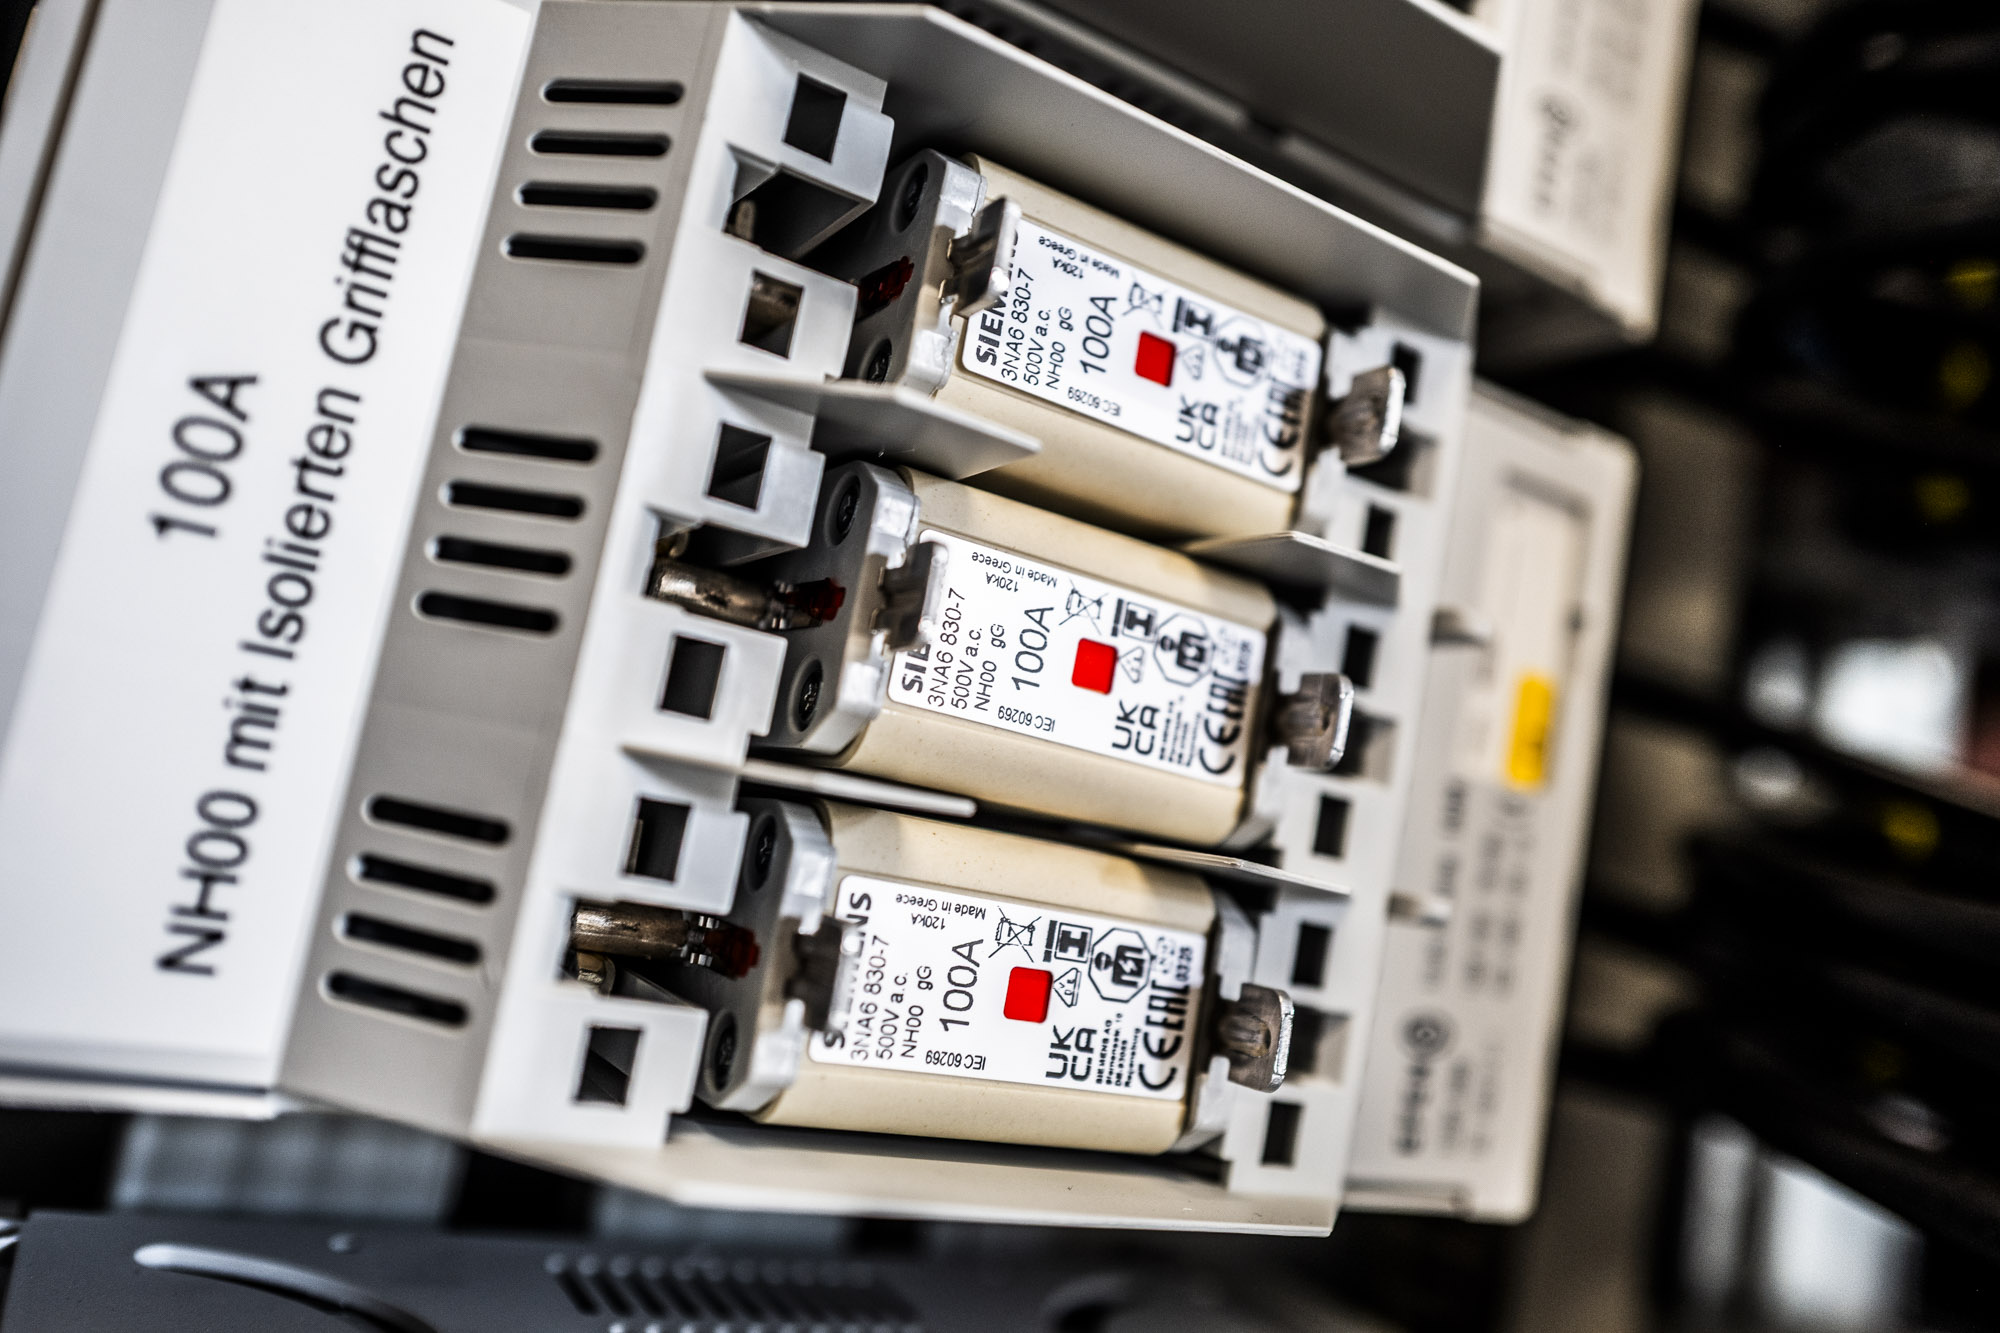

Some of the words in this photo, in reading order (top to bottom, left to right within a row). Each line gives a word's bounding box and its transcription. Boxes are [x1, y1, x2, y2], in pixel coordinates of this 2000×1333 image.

[319, 27, 456, 366] Grifflaschen
[1038, 235, 1077, 261] Greece
[1011, 267, 1035, 324] 830-7
[1001, 327, 1025, 381] 3NA6
[1023, 337, 1045, 386] 500V
[1036, 309, 1051, 337] a.c.
[1045, 341, 1066, 390] NH00
[1058, 306, 1075, 332] gG
[1079, 296, 1118, 374] 100A
[1103, 399, 1121, 417] IEC
[149, 374, 259, 540] 100A
[240, 385, 361, 660] Isolierten
[971, 551, 1012, 574] Greece
[985, 571, 1019, 593] 120kA
[1015, 564, 1025, 579] in
[1027, 569, 1058, 588] Made
[940, 587, 965, 645] 830-7
[951, 659, 975, 710] 500V
[965, 627, 982, 657] a.c.
[974, 660, 997, 711] NH00
[990, 624, 1006, 649] gG
[1011, 607, 1054, 691] 100A
[927, 650, 954, 707] 3NA6
[223, 676, 291, 772] mit
[998, 705, 1033, 726] 60269
[1034, 715, 1056, 733] IEC
[1112, 700, 1139, 750] UK
[1135, 705, 1160, 755] CA
[155, 788, 259, 976] NH00
[895, 893, 938, 912] Greece
[941, 902, 952, 915] in
[911, 912, 946, 930] 120kA
[954, 903, 987, 921] Made
[850, 1002, 878, 1061] 3NA6
[864, 935, 890, 995] 830-7
[900, 1005, 924, 1058] NH00
[916, 965, 934, 991] gG
[939, 939, 984, 1032] 100A
[875, 1008, 900, 1060] 500V
[890, 972, 909, 1004] a.c.
[925, 1050, 962, 1068] 60269
[964, 1054, 987, 1071] IEC
[1045, 1025, 1075, 1080] UK
[1070, 1027, 1097, 1082] CA
